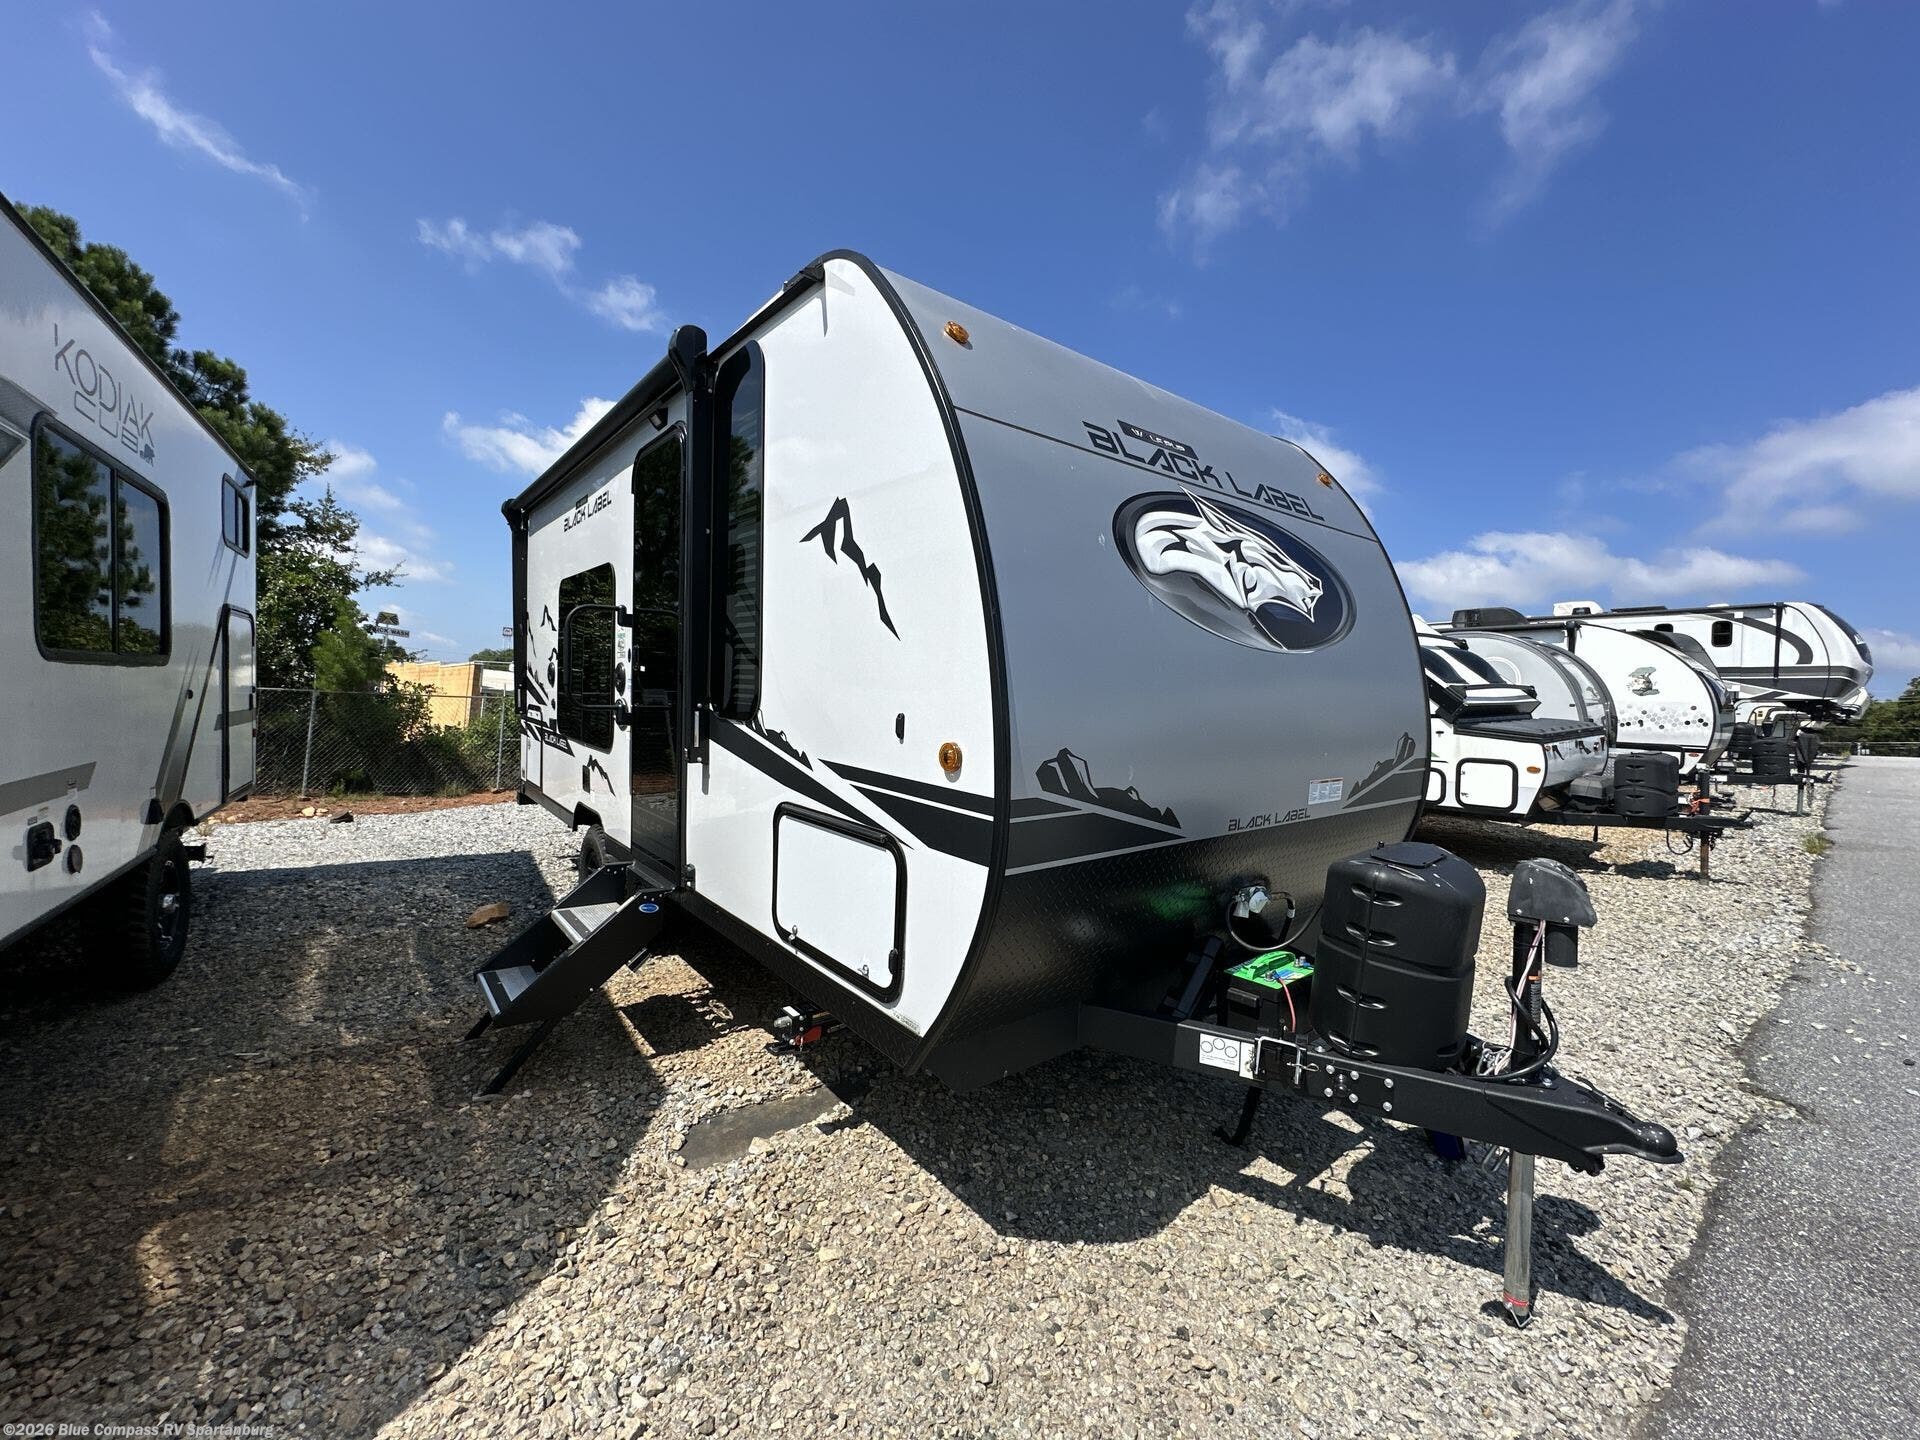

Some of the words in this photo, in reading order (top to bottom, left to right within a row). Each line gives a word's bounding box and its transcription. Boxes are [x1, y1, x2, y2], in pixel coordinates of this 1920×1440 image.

[54, 323, 155, 448] KODIAK
[74, 390, 140, 454] CUB
[1082, 420, 1223, 489] BLACK
[1225, 471, 1325, 521] LABEL
[564, 506, 587, 532] BLACK
[587, 490, 612, 519] LABEL
[1228, 813, 1272, 832] BLACK
[1274, 807, 1311, 823] LABEL
